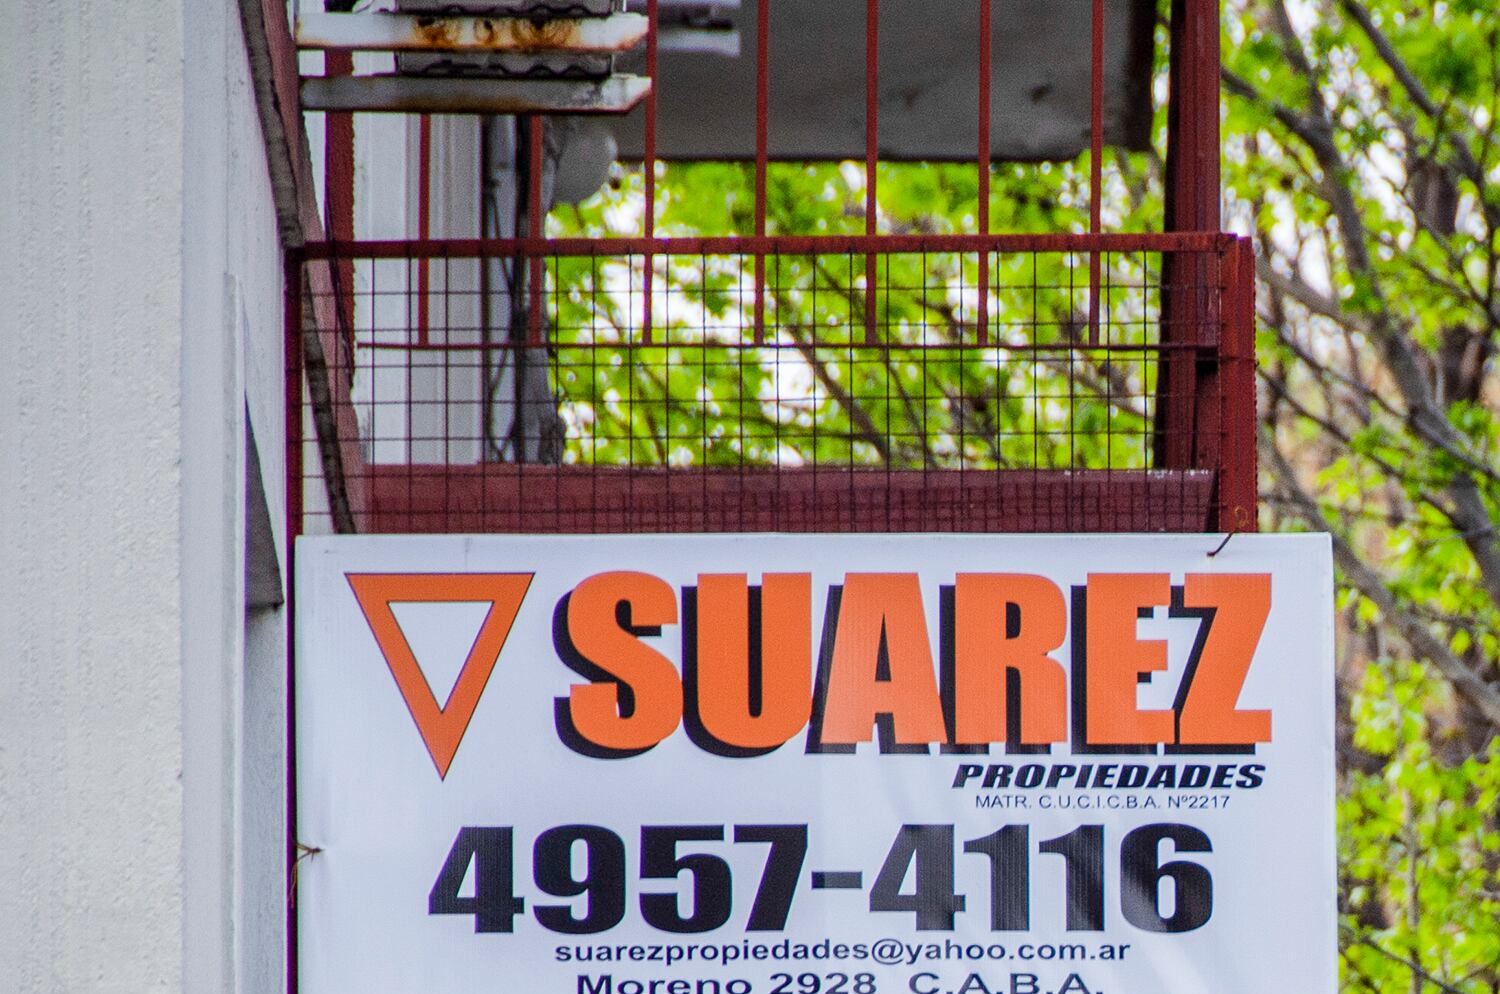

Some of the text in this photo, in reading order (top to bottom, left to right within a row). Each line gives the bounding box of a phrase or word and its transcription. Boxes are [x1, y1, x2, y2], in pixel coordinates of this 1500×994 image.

[553, 571, 1272, 757] SUAREZ
[952, 764, 1266, 789] PROPIEDADES
[975, 795, 1032, 809] MATR.
[1039, 795, 1161, 809] C.U.C.I.C.B.A.
[428, 823, 1215, 934] 4957-4116
[555, 938, 1131, 965] suarezpropiedades@yahoo.com.ar
